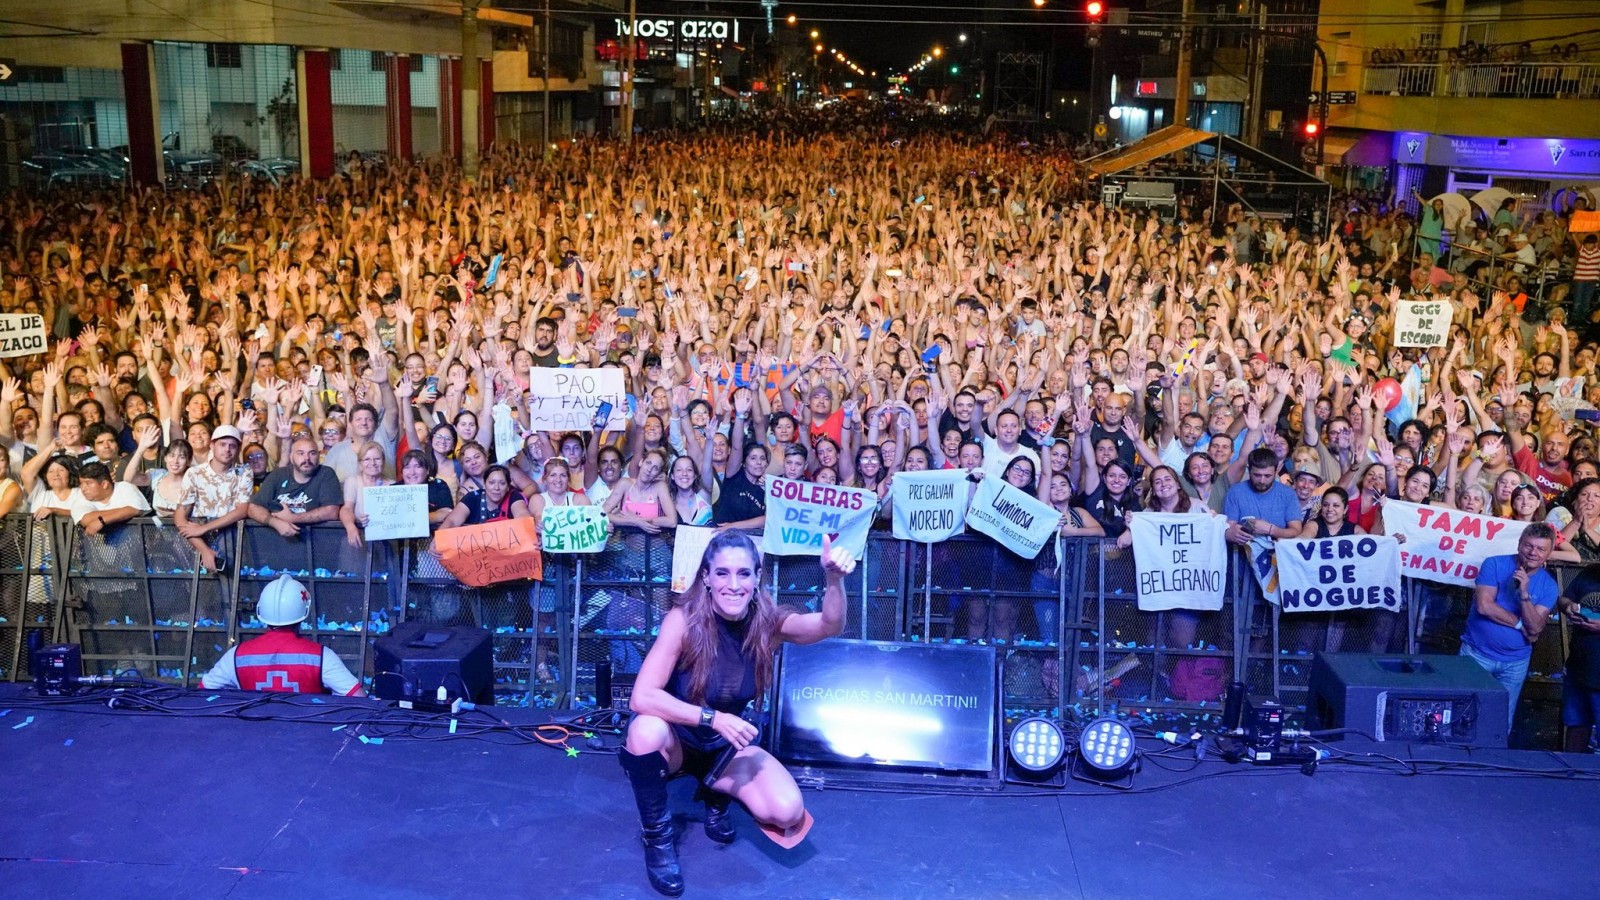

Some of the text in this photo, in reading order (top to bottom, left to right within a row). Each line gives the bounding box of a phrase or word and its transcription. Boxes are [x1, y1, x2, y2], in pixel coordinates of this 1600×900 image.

[1569, 149, 1586, 158] San
[21, 316, 41, 330] DE
[1418, 318, 1433, 330] DE
[1, 335, 42, 352] ZACO
[554, 373, 595, 394] PAO
[909, 484, 954, 500] PRI GALVAN
[1536, 474, 1569, 491] DOORS
[770, 479, 863, 510] SOLERAS
[407, 503, 417, 512] DE
[991, 485, 1035, 531] Luminosa
[784, 507, 841, 529] DE MI
[909, 509, 954, 531] MORENO
[1417, 508, 1505, 540] TAMY
[781, 526, 823, 546] VIDA
[970, 506, 1042, 551] MALVINAS ARGENTINAS
[1160, 523, 1201, 546] MEL
[456, 527, 521, 559] KARLA
[545, 534, 565, 550] DE
[1296, 537, 1377, 561] VERO
[1438, 536, 1467, 554] DE
[475, 556, 492, 571] DE
[1173, 549, 1188, 564] DE
[477, 557, 541, 584] CASANOVA
[1319, 564, 1356, 584] DE
[1140, 568, 1220, 596] BELGRANO
[1283, 586, 1396, 608] NOGUES
[874, 690, 906, 705] SAN
[910, 692, 977, 709] MARTIN!!
